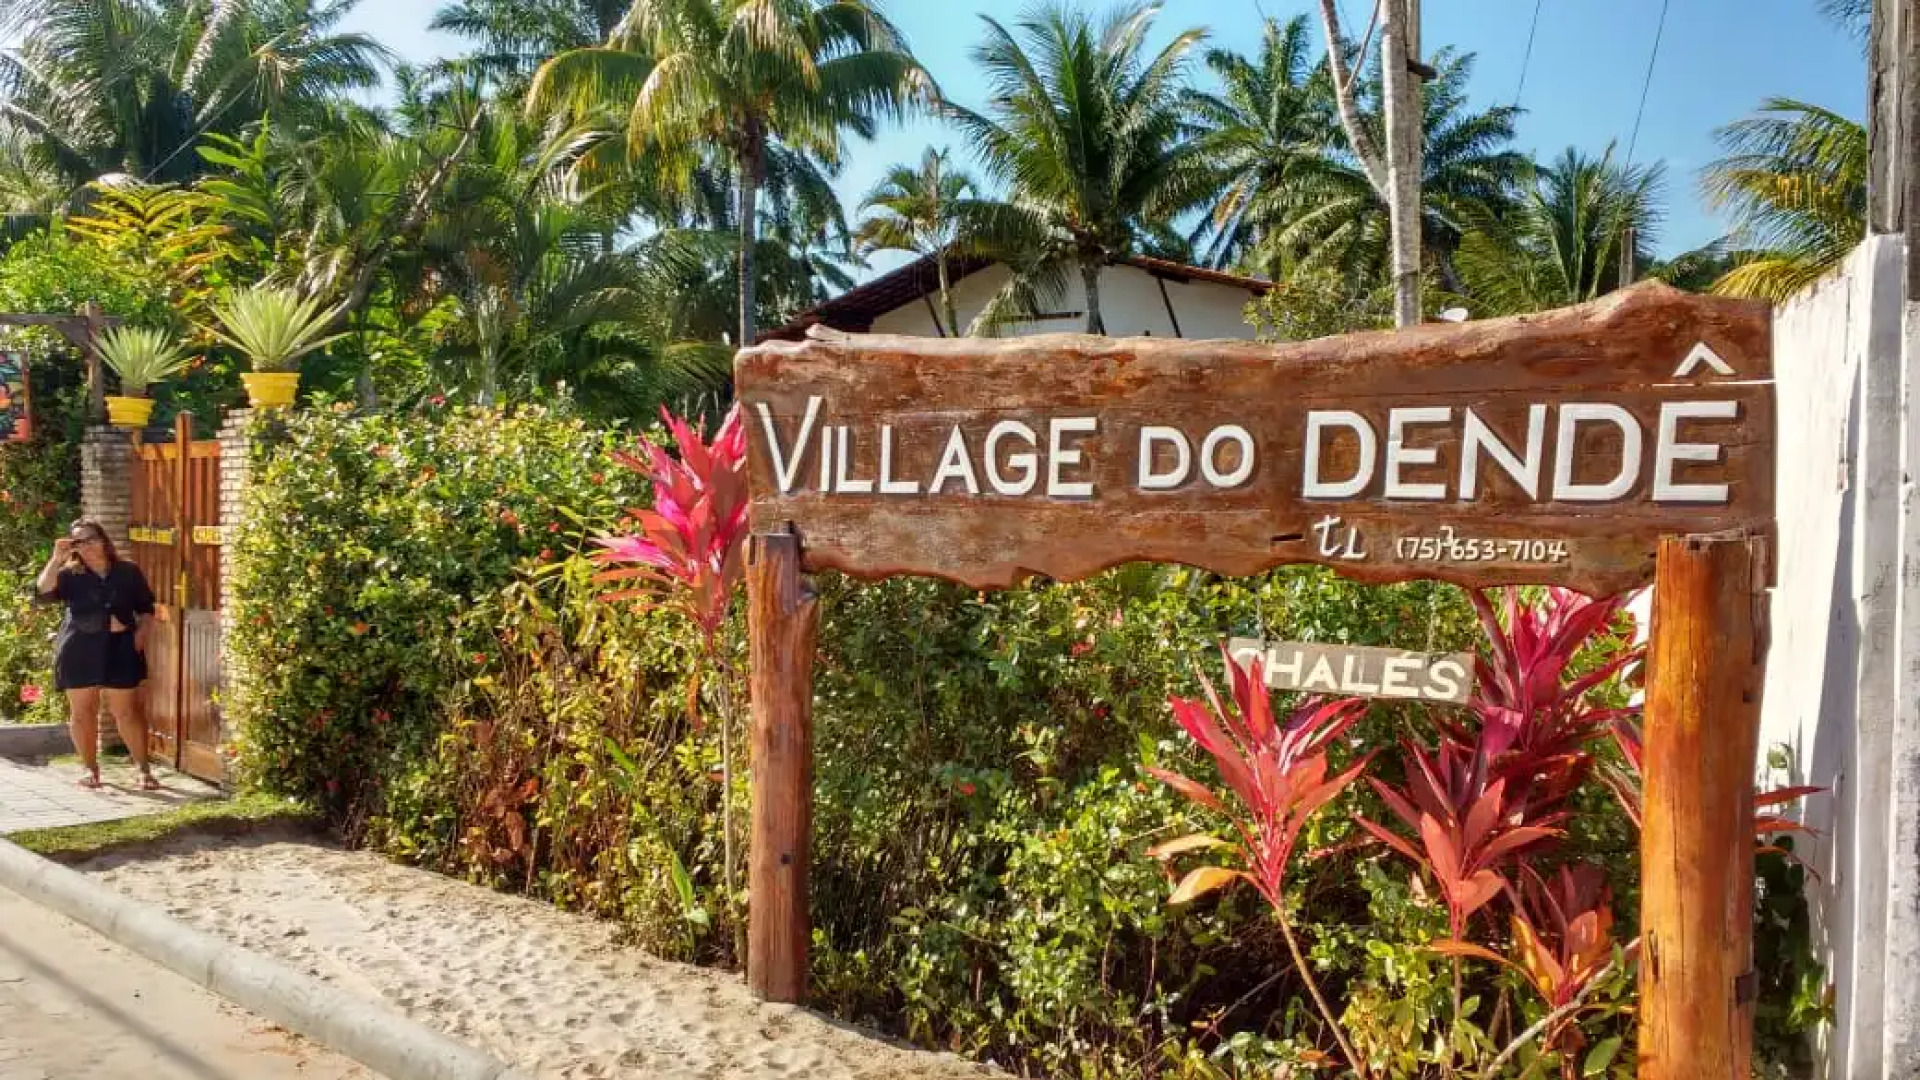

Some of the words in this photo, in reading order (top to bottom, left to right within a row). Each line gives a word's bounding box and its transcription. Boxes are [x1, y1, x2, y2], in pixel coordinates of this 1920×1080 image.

[756, 396, 1097, 497] VILLAGE
[1138, 424, 1255, 489] DO
[1302, 341, 1739, 502] DENDÊ
